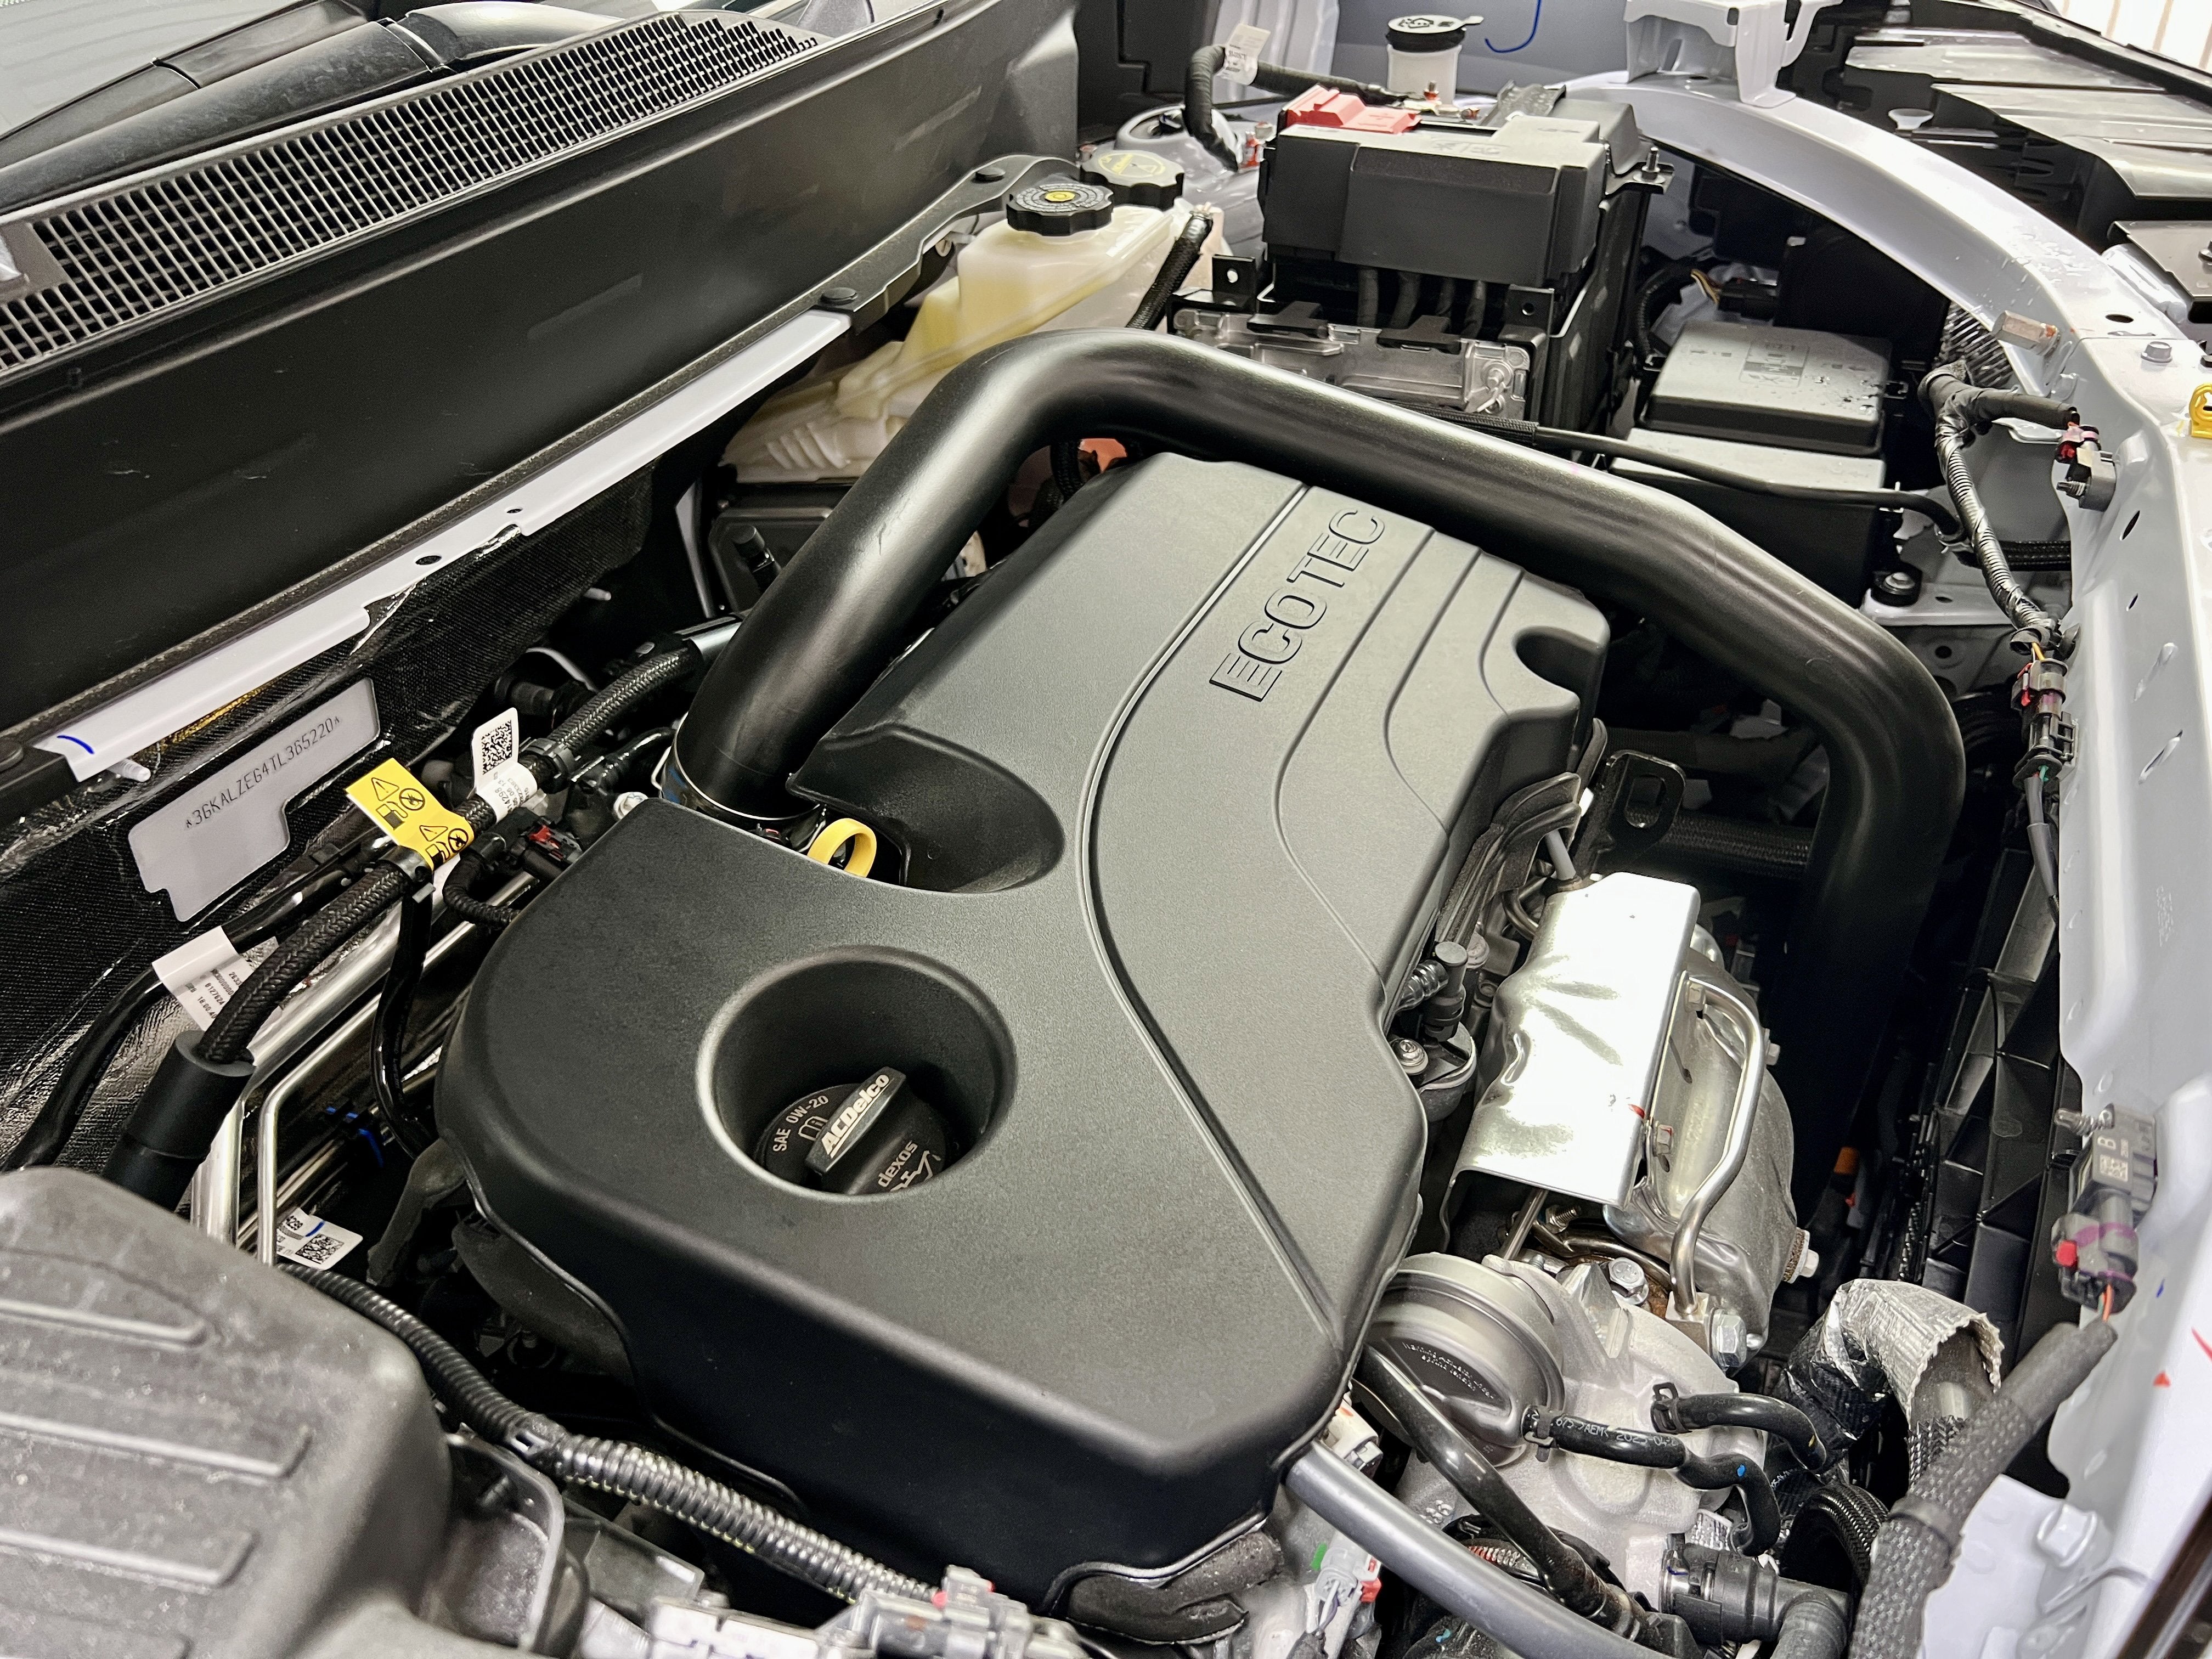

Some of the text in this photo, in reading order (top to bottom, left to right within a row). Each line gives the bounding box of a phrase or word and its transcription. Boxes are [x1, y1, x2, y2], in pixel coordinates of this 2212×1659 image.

[1209, 509, 1385, 702] ECOTEC
[772, 1095, 830, 1152] SAE 0W-20
[821, 1074, 889, 1155] ACDelco
[878, 1140, 918, 1187] dexos
